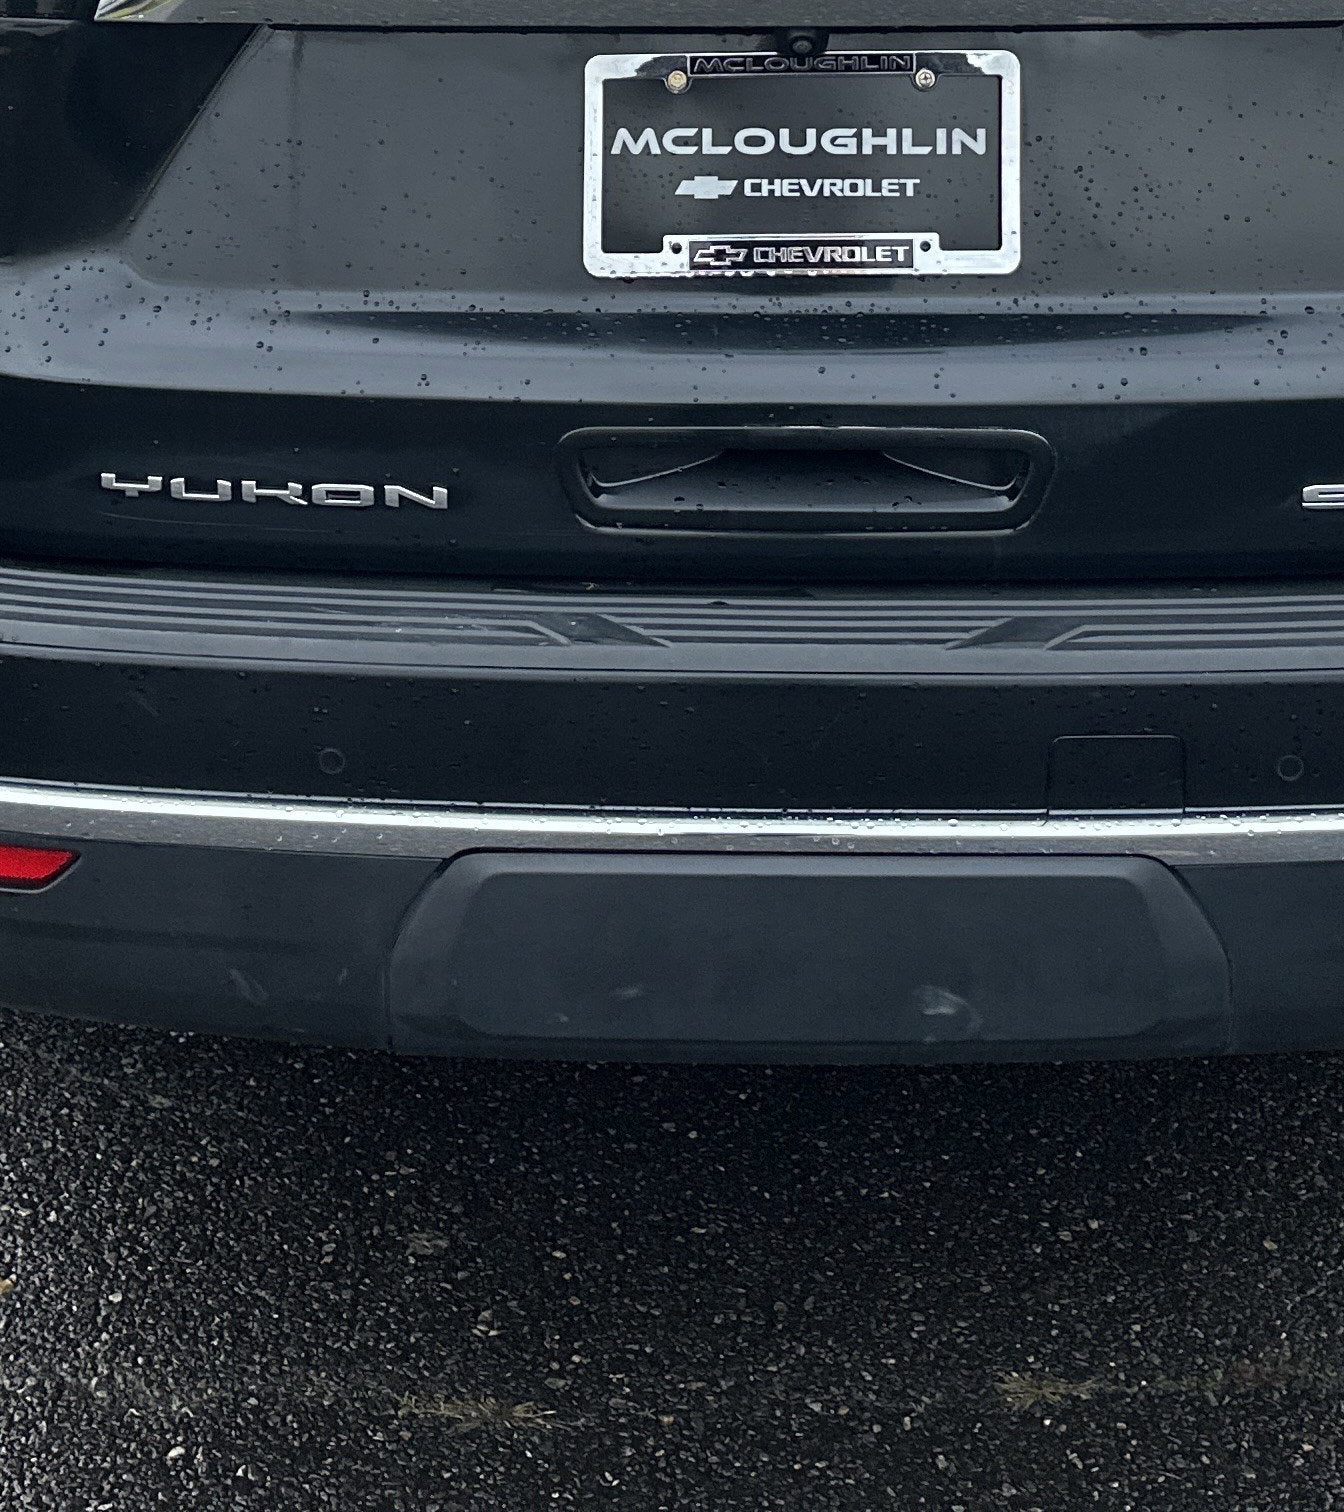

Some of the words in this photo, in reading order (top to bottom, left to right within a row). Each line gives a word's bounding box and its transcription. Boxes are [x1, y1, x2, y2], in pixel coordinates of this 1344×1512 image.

[692, 55, 912, 72] MCLOUGHLIN
[610, 127, 987, 156] MCLOUGHLIN
[743, 178, 921, 198] CHEVROLET
[753, 245, 910, 264] CHEVROLET
[101, 473, 449, 509] YUKON
